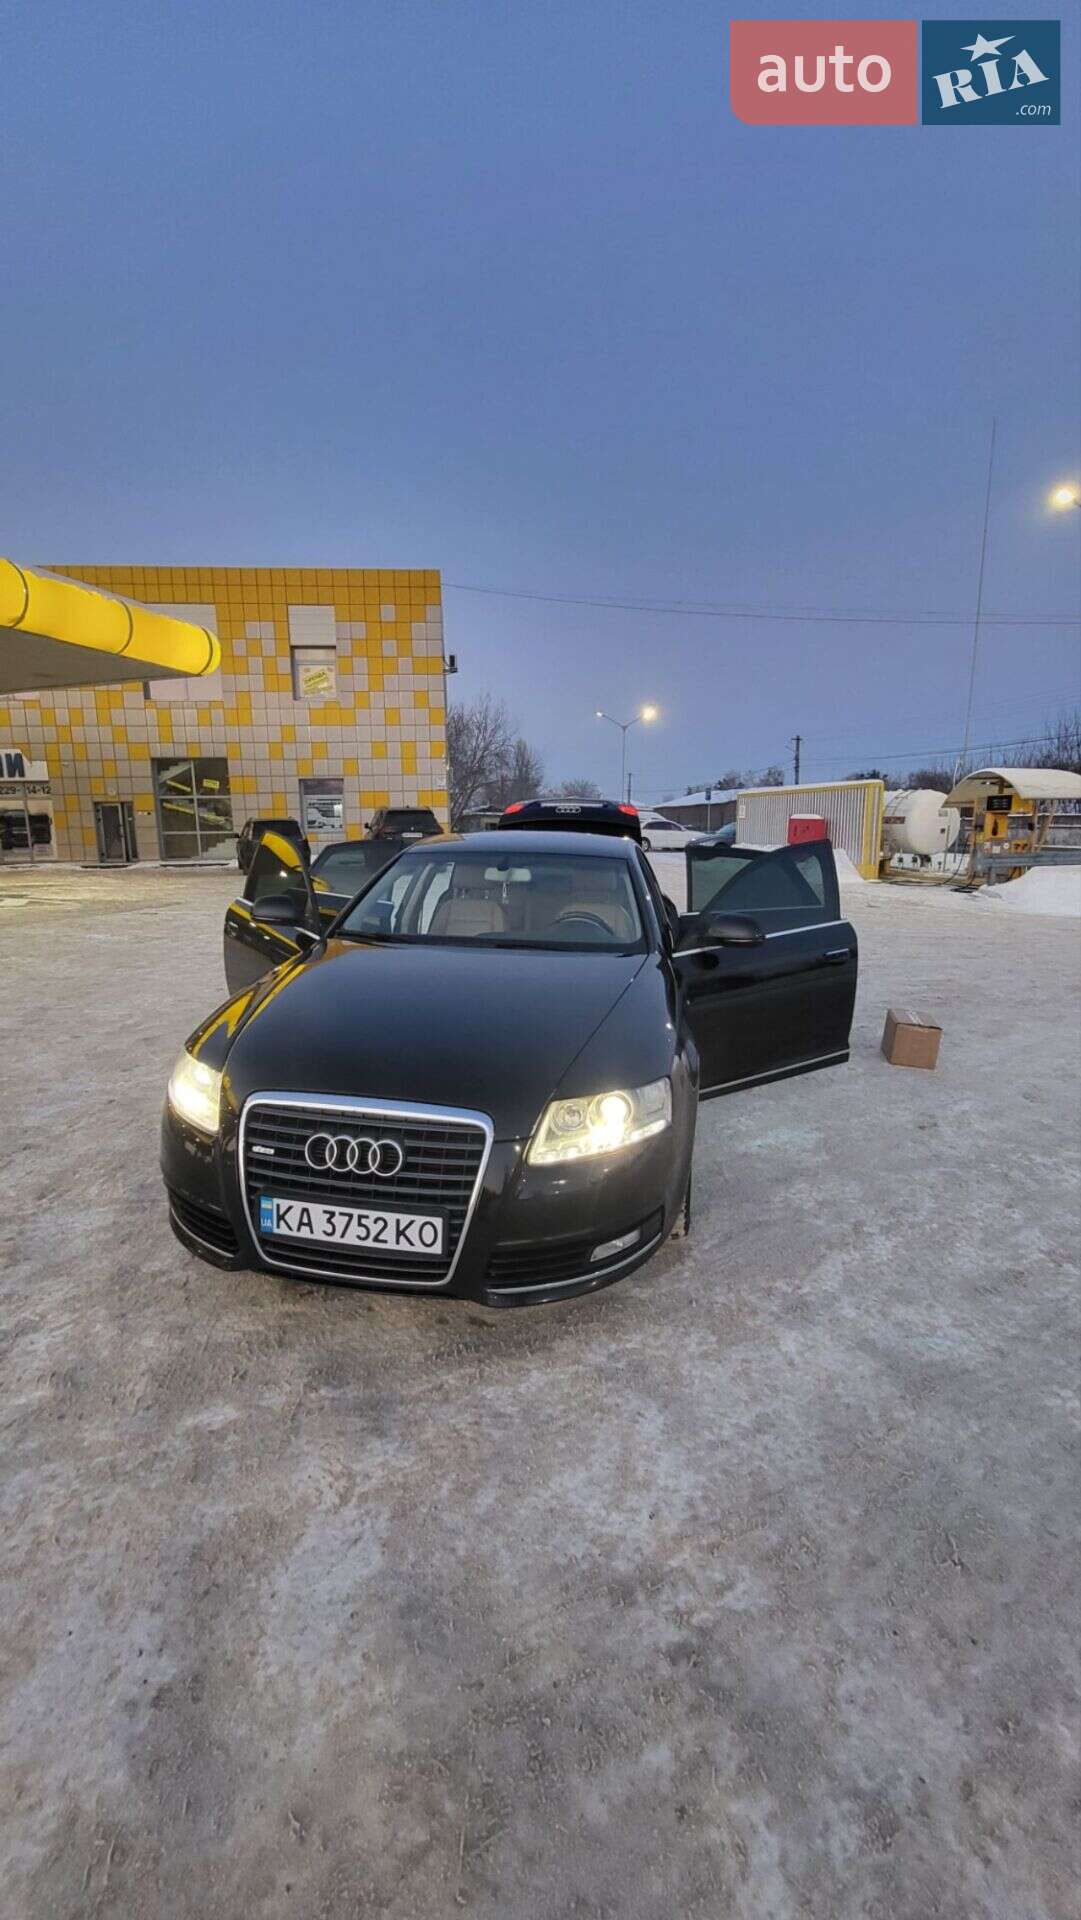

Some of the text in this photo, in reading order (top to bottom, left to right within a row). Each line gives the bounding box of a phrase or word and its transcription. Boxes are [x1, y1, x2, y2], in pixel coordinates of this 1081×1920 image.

[0, 752, 26, 778] И
[260, 1217, 272, 1228] UA
[275, 1203, 439, 1248] KA 3752 KO
